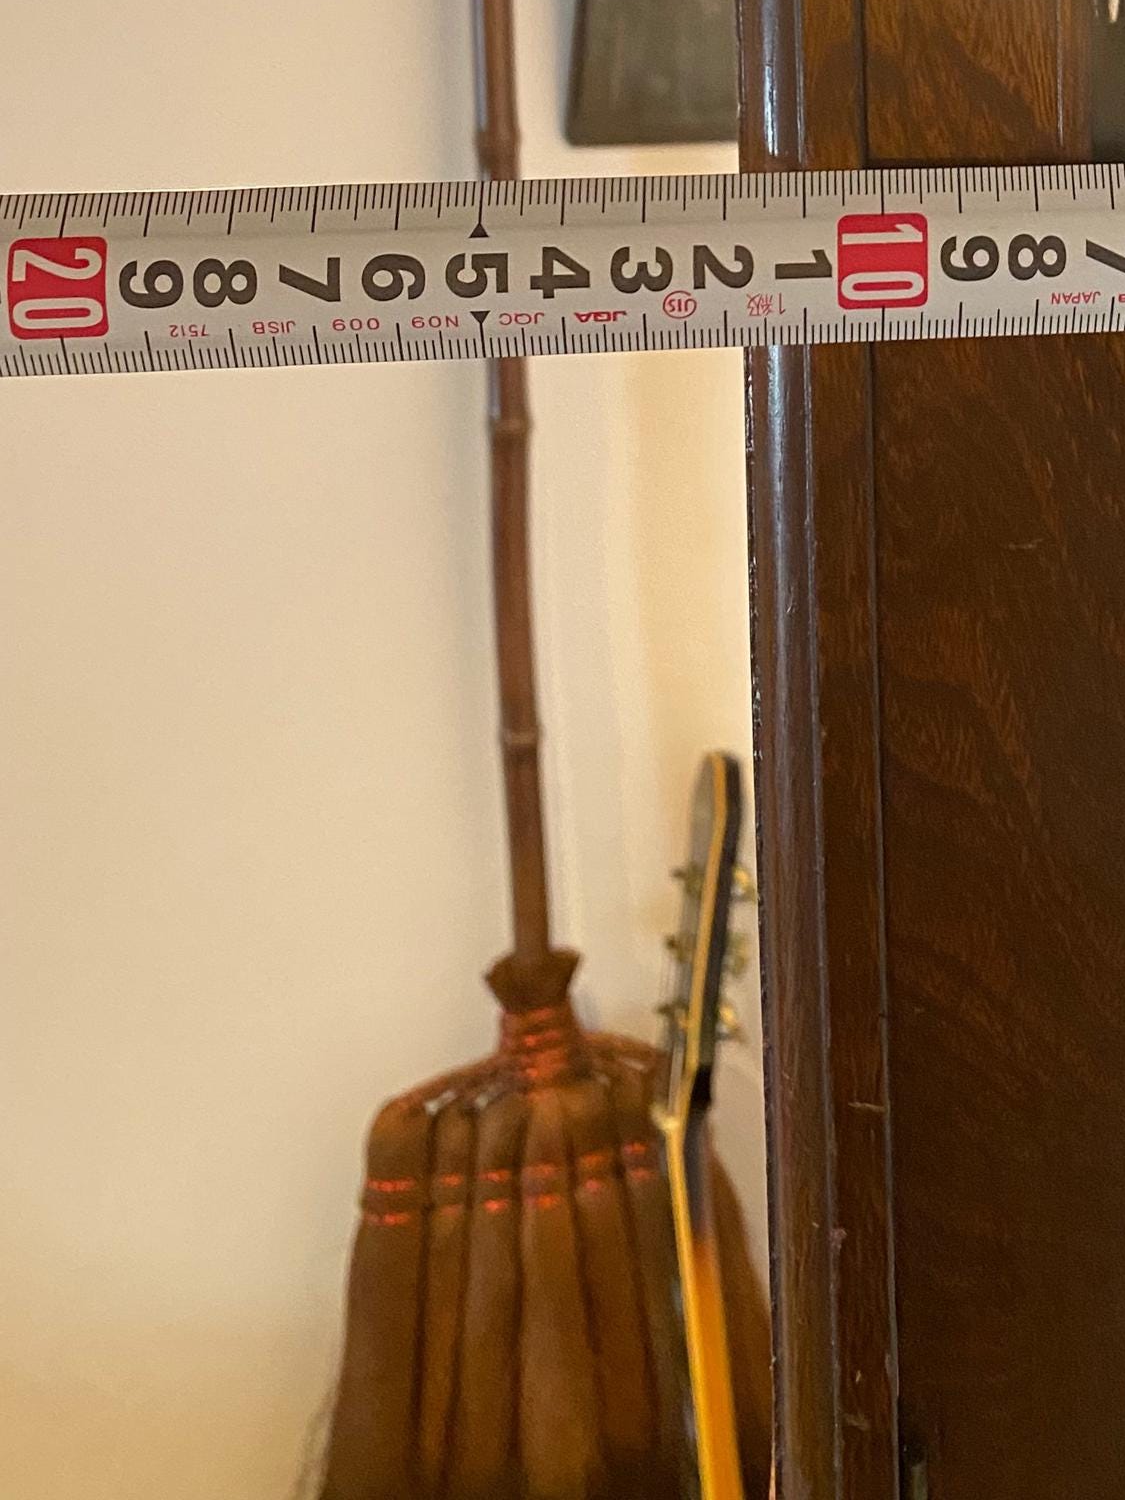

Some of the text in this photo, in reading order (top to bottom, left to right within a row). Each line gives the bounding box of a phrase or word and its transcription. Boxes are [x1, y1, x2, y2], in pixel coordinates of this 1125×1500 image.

[279, 257, 341, 303] 7
[361, 253, 426, 302] 6
[446, 252, 509, 299] 5
[530, 246, 591, 300] 4
[610, 246, 674, 294] 3
[692, 244, 754, 290] 2
[775, 249, 833, 280] 1
[841, 223, 925, 301] 10
[940, 236, 999, 282] 9
[1007, 233, 1067, 281] 8
[11, 246, 103, 331] 20
[119, 259, 183, 308] 9
[193, 258, 257, 308] 8
[746, 293, 786, 317] 1級
[1050, 290, 1101, 306] JAPAN
[498, 311, 546, 326] JQC
[573, 309, 627, 324] JQA
[664, 295, 697, 318] JIS
[168, 323, 208, 339] 7512
